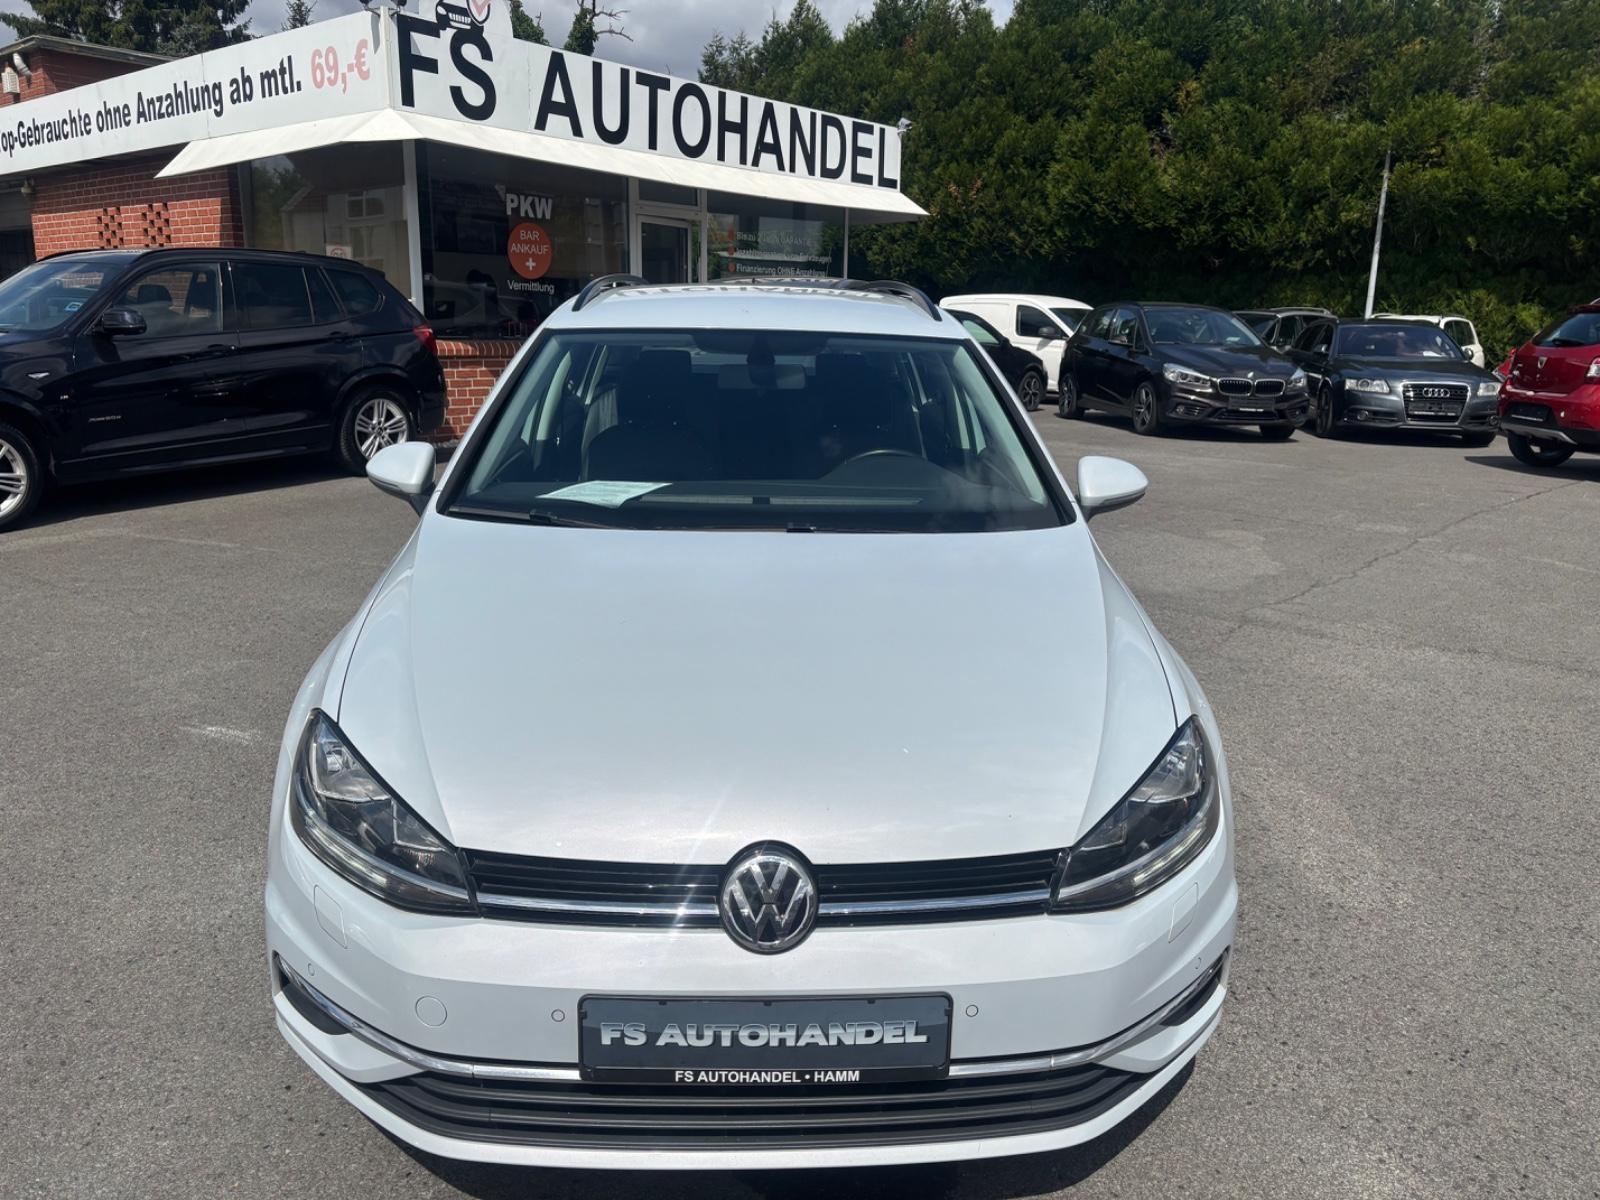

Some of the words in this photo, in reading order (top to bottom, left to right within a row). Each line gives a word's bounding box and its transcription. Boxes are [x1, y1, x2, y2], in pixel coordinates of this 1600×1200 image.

[0, 108, 92, 158] op-Gebrauchte
[96, 100, 131, 133] ohne
[137, 80, 224, 118] Anzahlung
[229, 66, 254, 105] ab
[260, 55, 301, 98] mtl.
[397, 13, 497, 121] FS
[534, 51, 898, 190] AUTOHANDEL
[505, 193, 552, 220] PKW
[520, 230, 540, 241] BAR
[510, 243, 549, 255] ANKAUF
[507, 280, 555, 295] Vermittlung
[600, 1022, 648, 1047] FS
[655, 1020, 929, 1048] AUTOHANDEL
[675, 1070, 695, 1083] FS
[697, 1070, 802, 1084] AUTOHANDEL
[814, 1070, 861, 1083] HAMM
